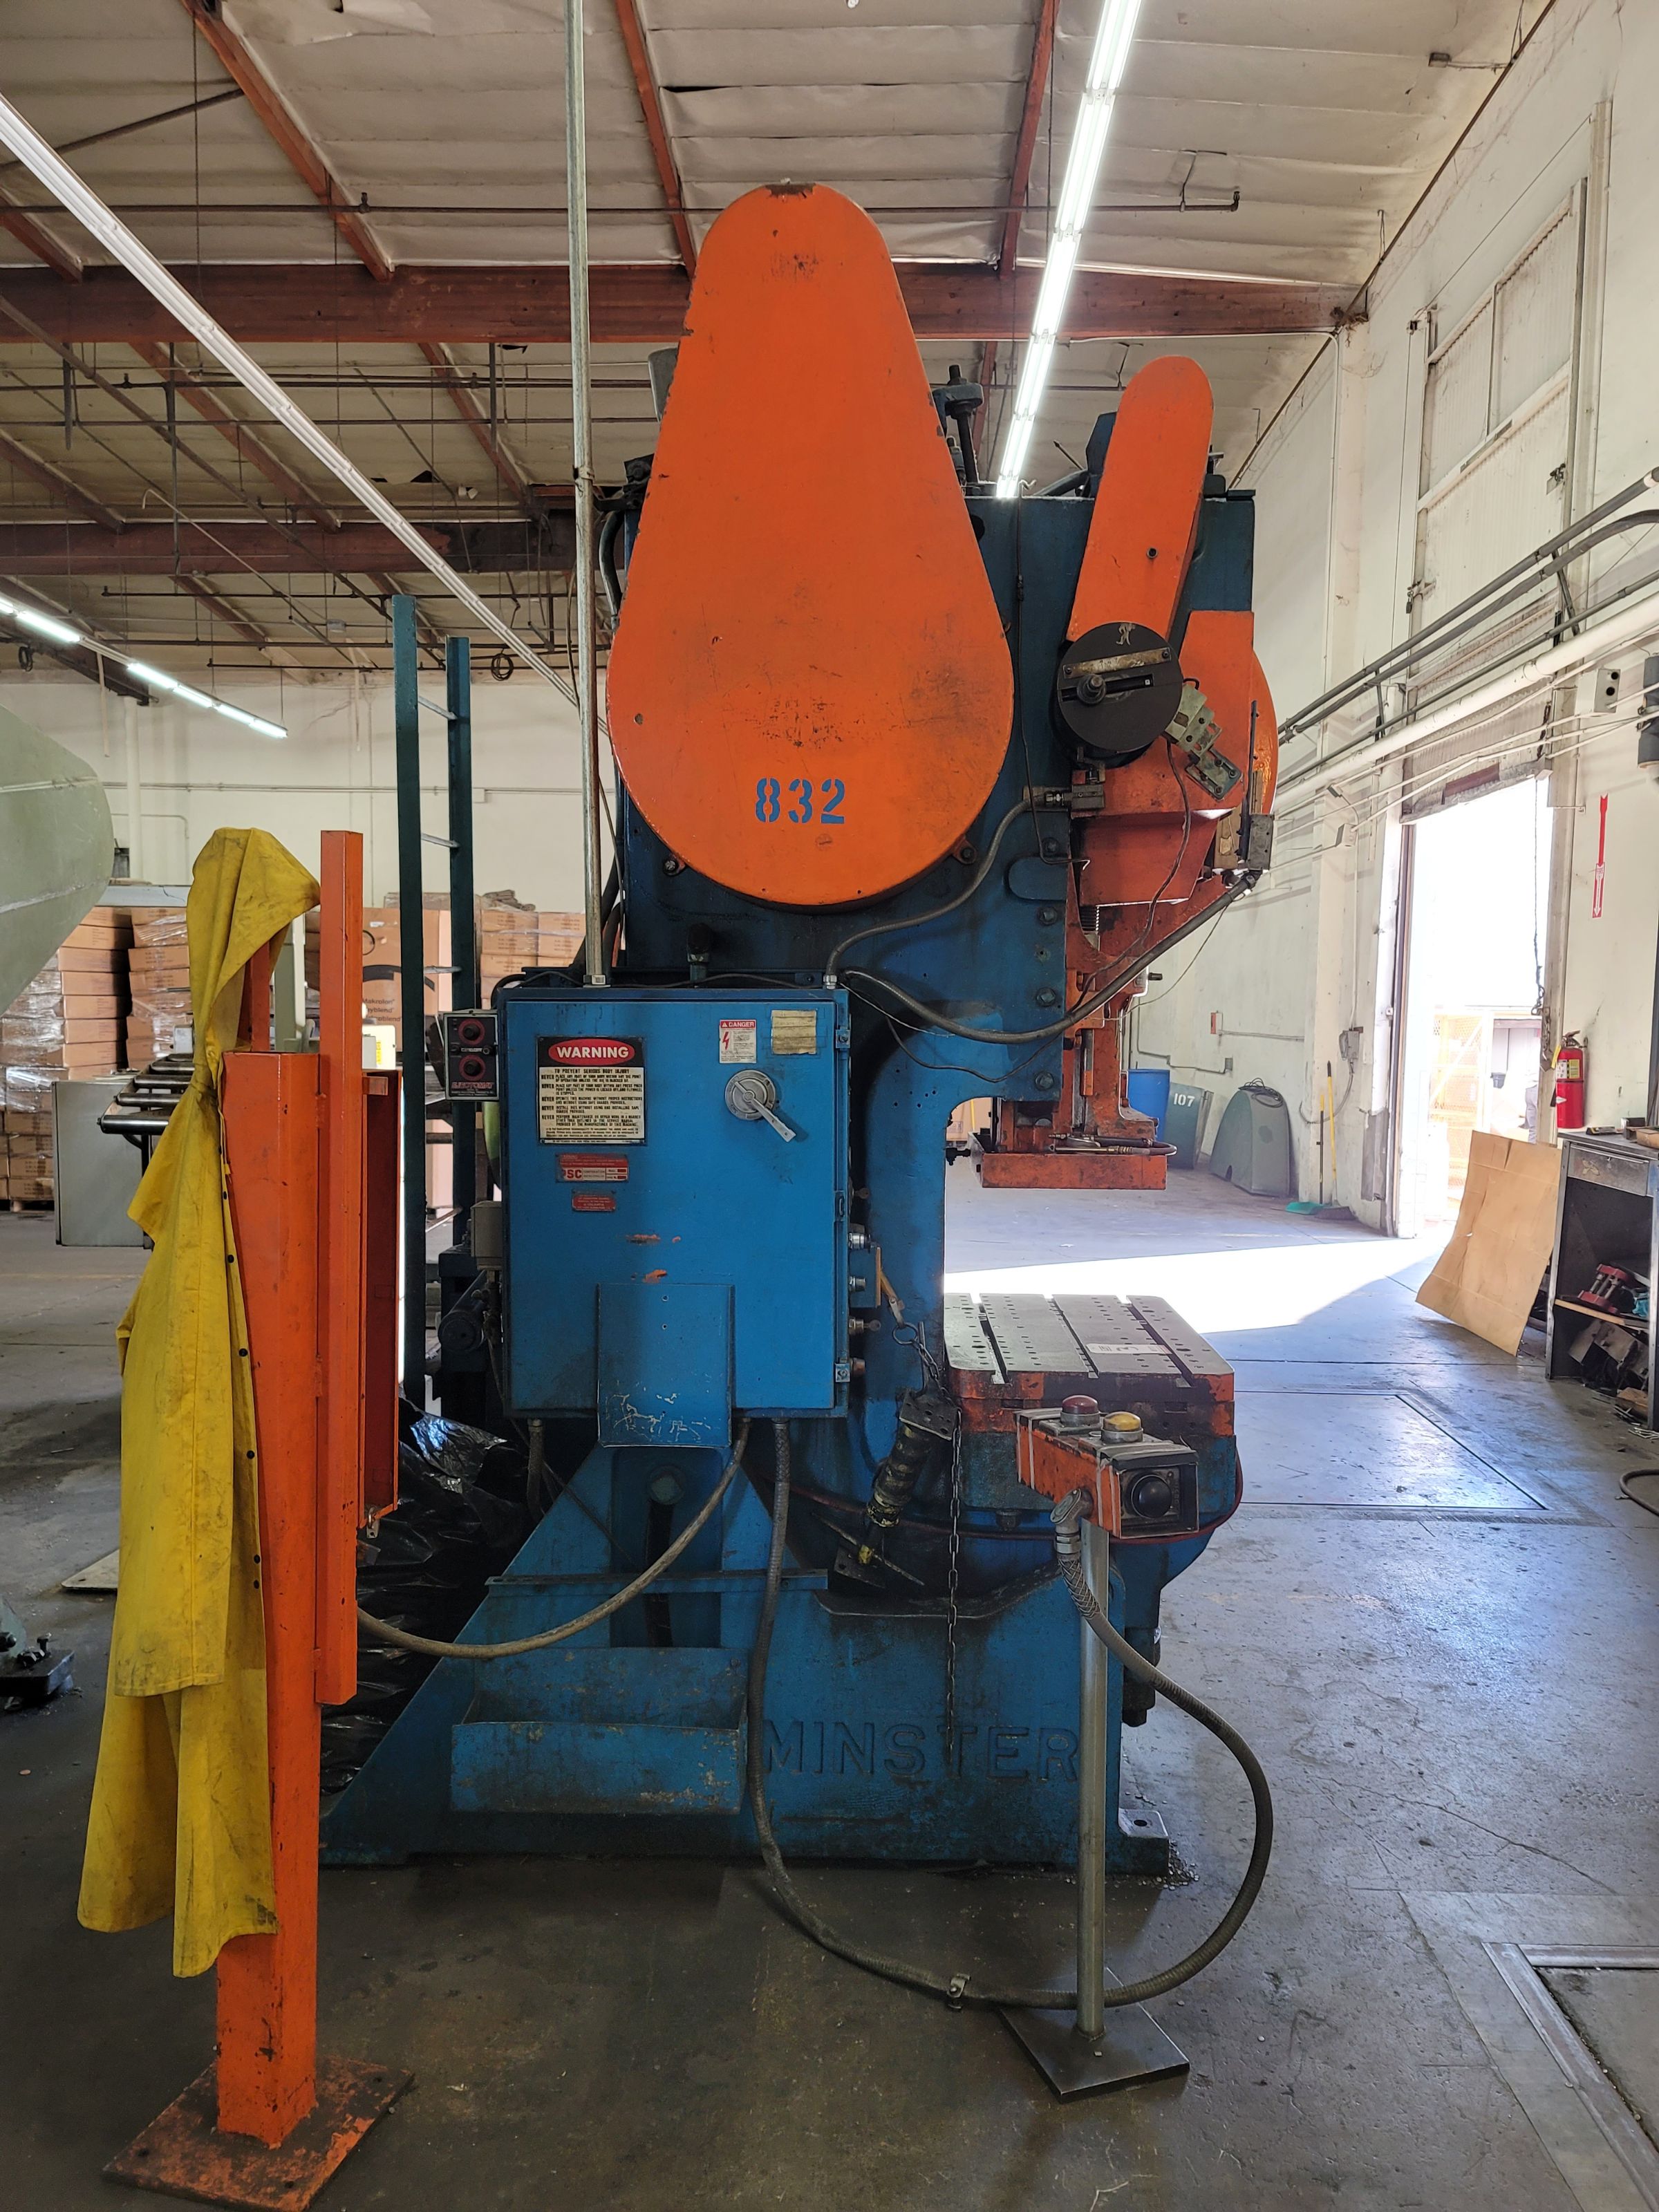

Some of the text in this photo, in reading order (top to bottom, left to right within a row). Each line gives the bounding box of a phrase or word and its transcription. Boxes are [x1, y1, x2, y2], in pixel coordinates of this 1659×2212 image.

[756, 778, 845, 824] 832
[556, 1046, 630, 1058] WARNING
[1173, 1093, 1195, 1107] 107
[760, 1720, 1079, 1781] MINSTER
